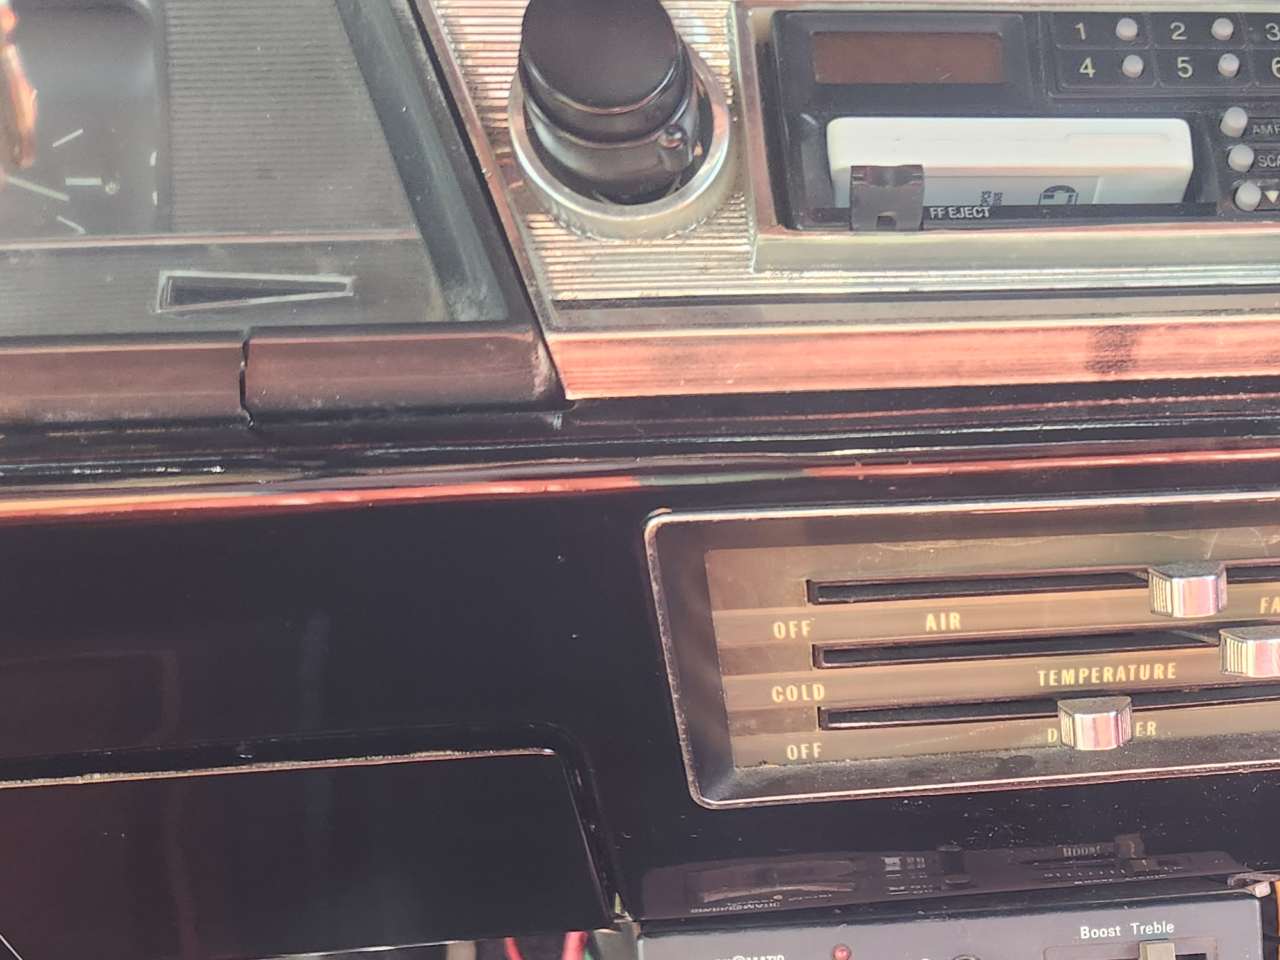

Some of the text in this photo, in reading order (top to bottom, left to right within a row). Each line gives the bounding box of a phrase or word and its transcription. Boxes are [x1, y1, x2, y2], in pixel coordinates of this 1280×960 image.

[1074, 22, 1086, 40] 1
[1170, 22, 1188, 40] 2
[1079, 57, 1096, 78] 4
[1177, 57, 1193, 78] 5
[948, 206, 991, 219] EJECT
[772, 619, 811, 639] OFF
[925, 612, 962, 632] AIR
[1037, 662, 1177, 687] TEMPERATURE
[771, 683, 825, 703] COLD
[786, 742, 822, 761] OFF
[1080, 920, 1175, 940] Boost Treble
